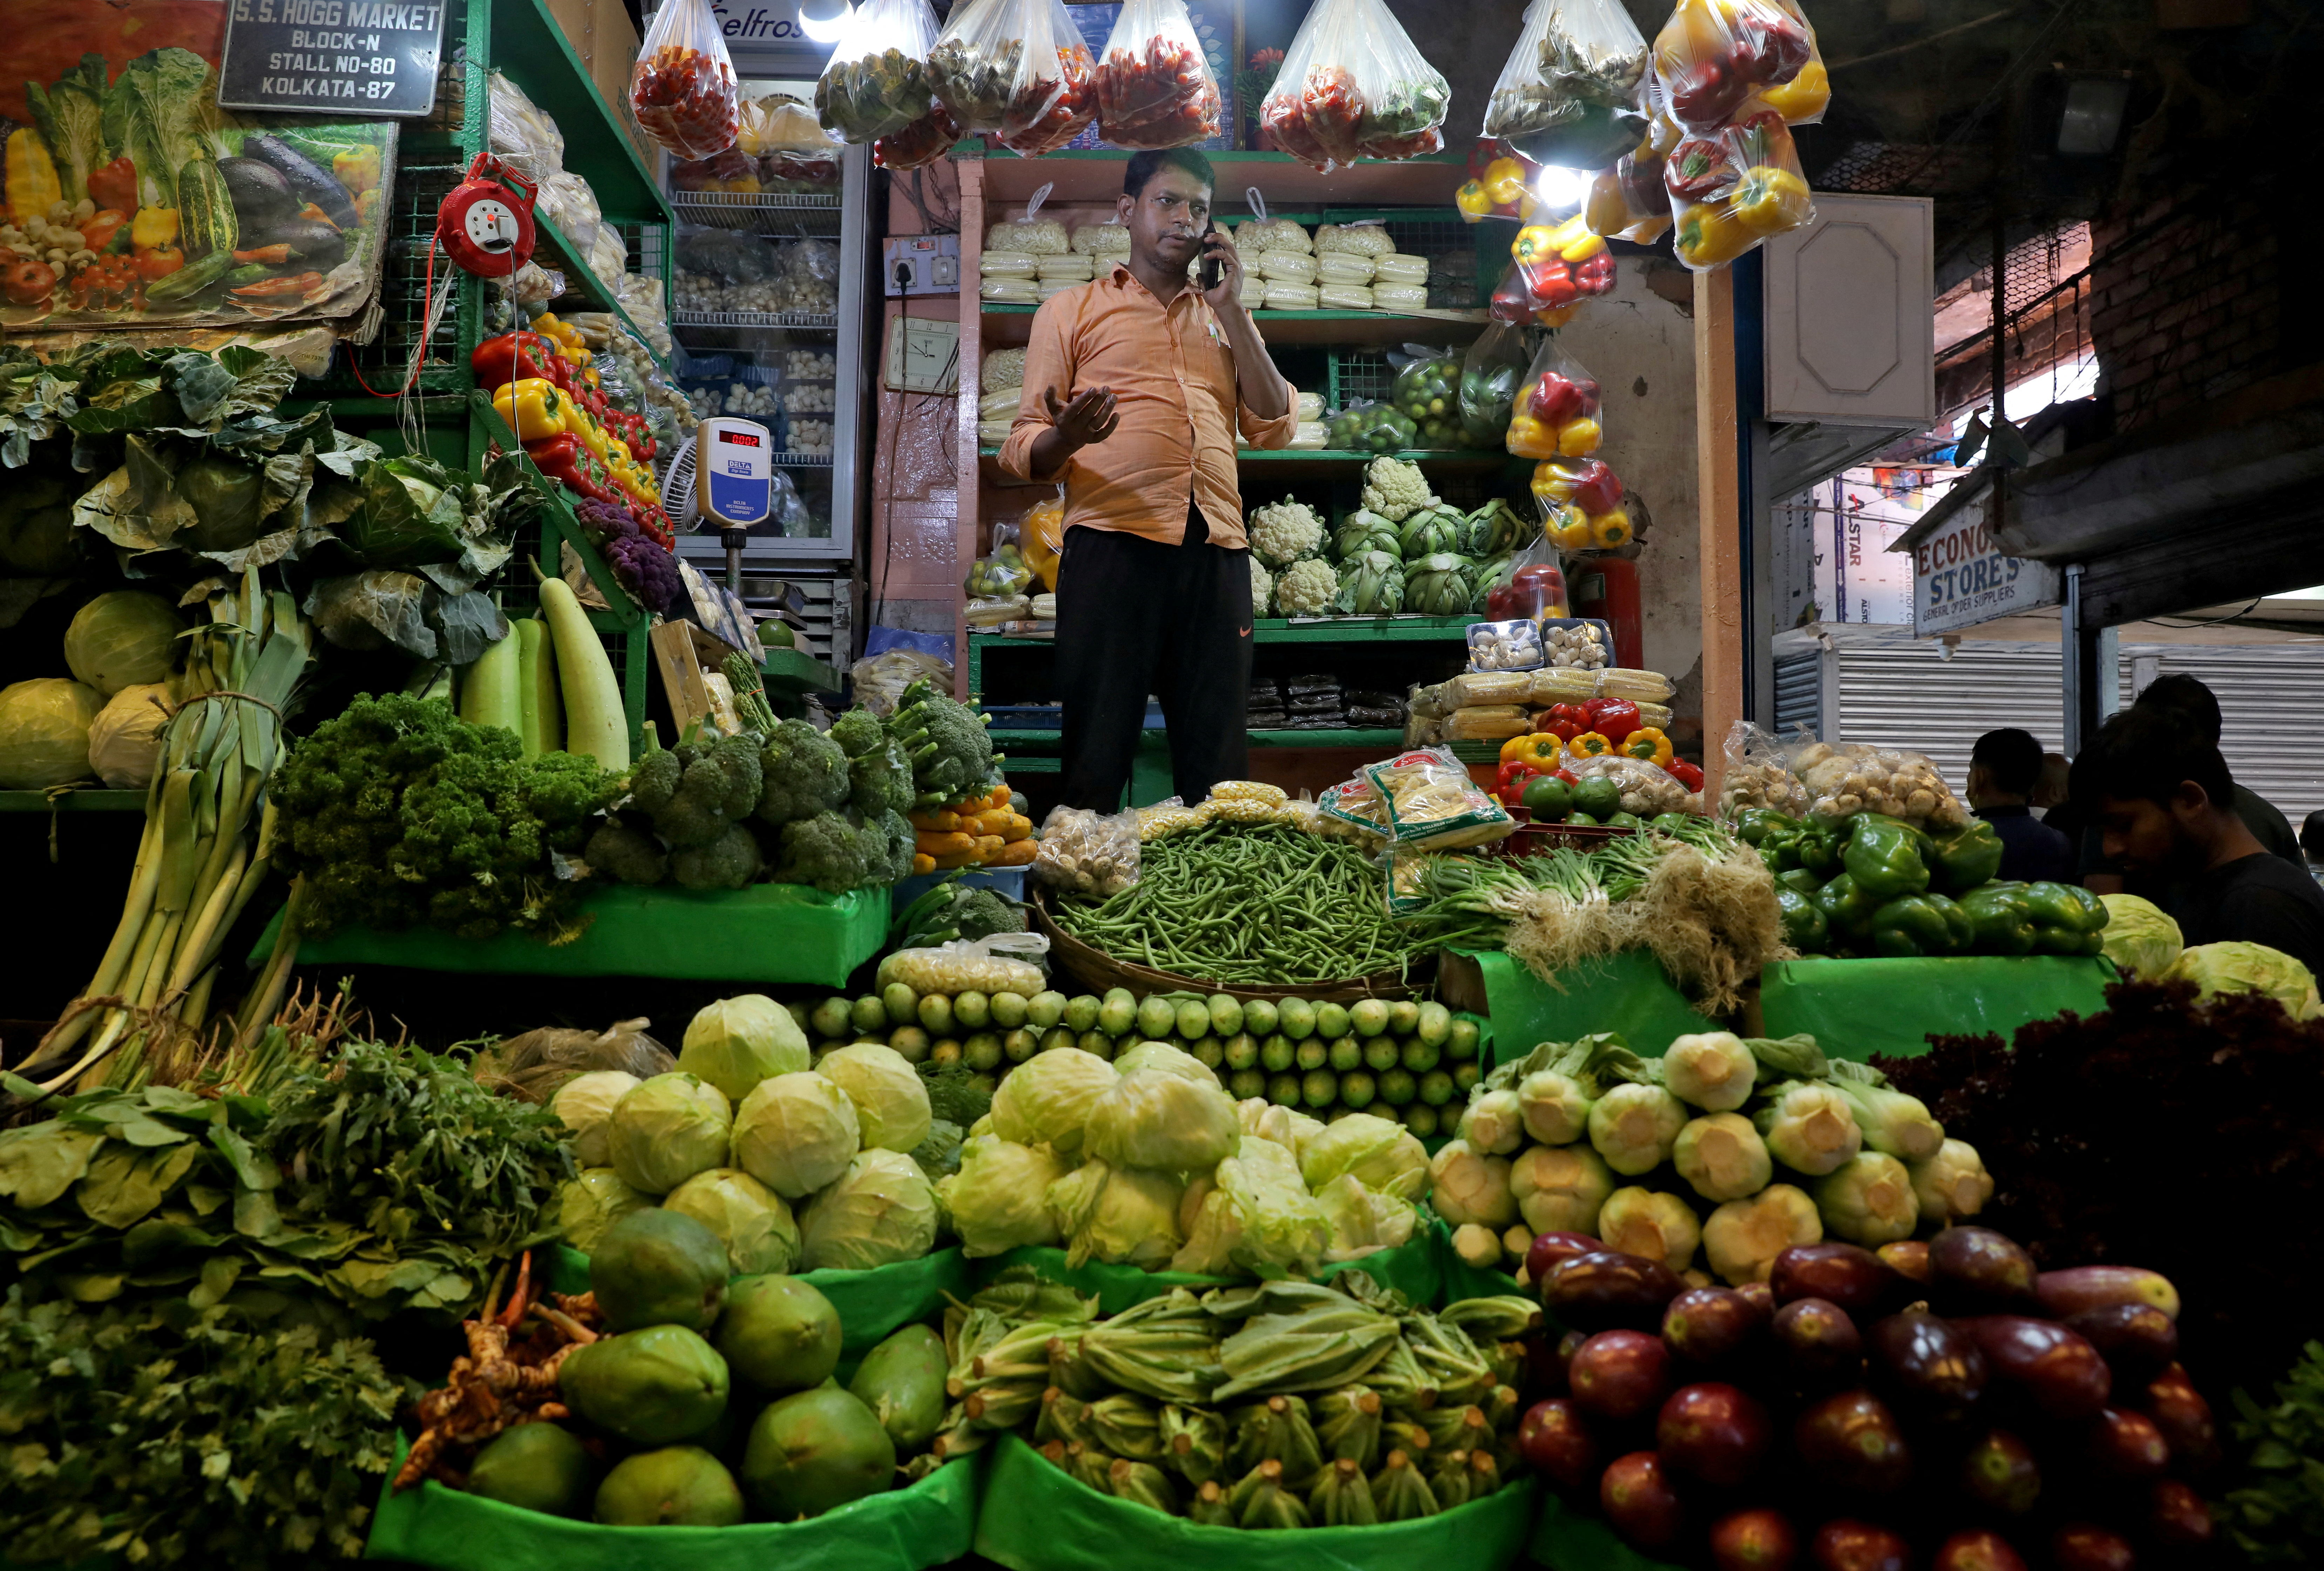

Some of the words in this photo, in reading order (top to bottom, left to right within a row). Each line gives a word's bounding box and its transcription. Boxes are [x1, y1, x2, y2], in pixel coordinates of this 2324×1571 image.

[235, 2, 255, 22] S.
[258, 2, 277, 23] S.
[282, 0, 342, 26] HOGG
[348, 1, 440, 31] MARKET
[713, 8, 807, 38] elfros
[292, 31, 380, 52] BLOCK-N
[270, 53, 330, 72] STALL
[336, 55, 396, 75] NO-80
[262, 77, 395, 99] KOLKATA-87
[732, 434, 758, 446] 0.002
[729, 461, 750, 469] DELTA
[1848, 494, 1864, 566] ALSTAR
[1918, 521, 1998, 577] ECONO
[1905, 568, 1913, 609] exterior
[1930, 553, 2019, 606] STORES
[1923, 605, 1949, 622] GENERAL
[1974, 585, 2015, 608] SUPPLIERS
[1422, 821, 1445, 830] WELLNESS
